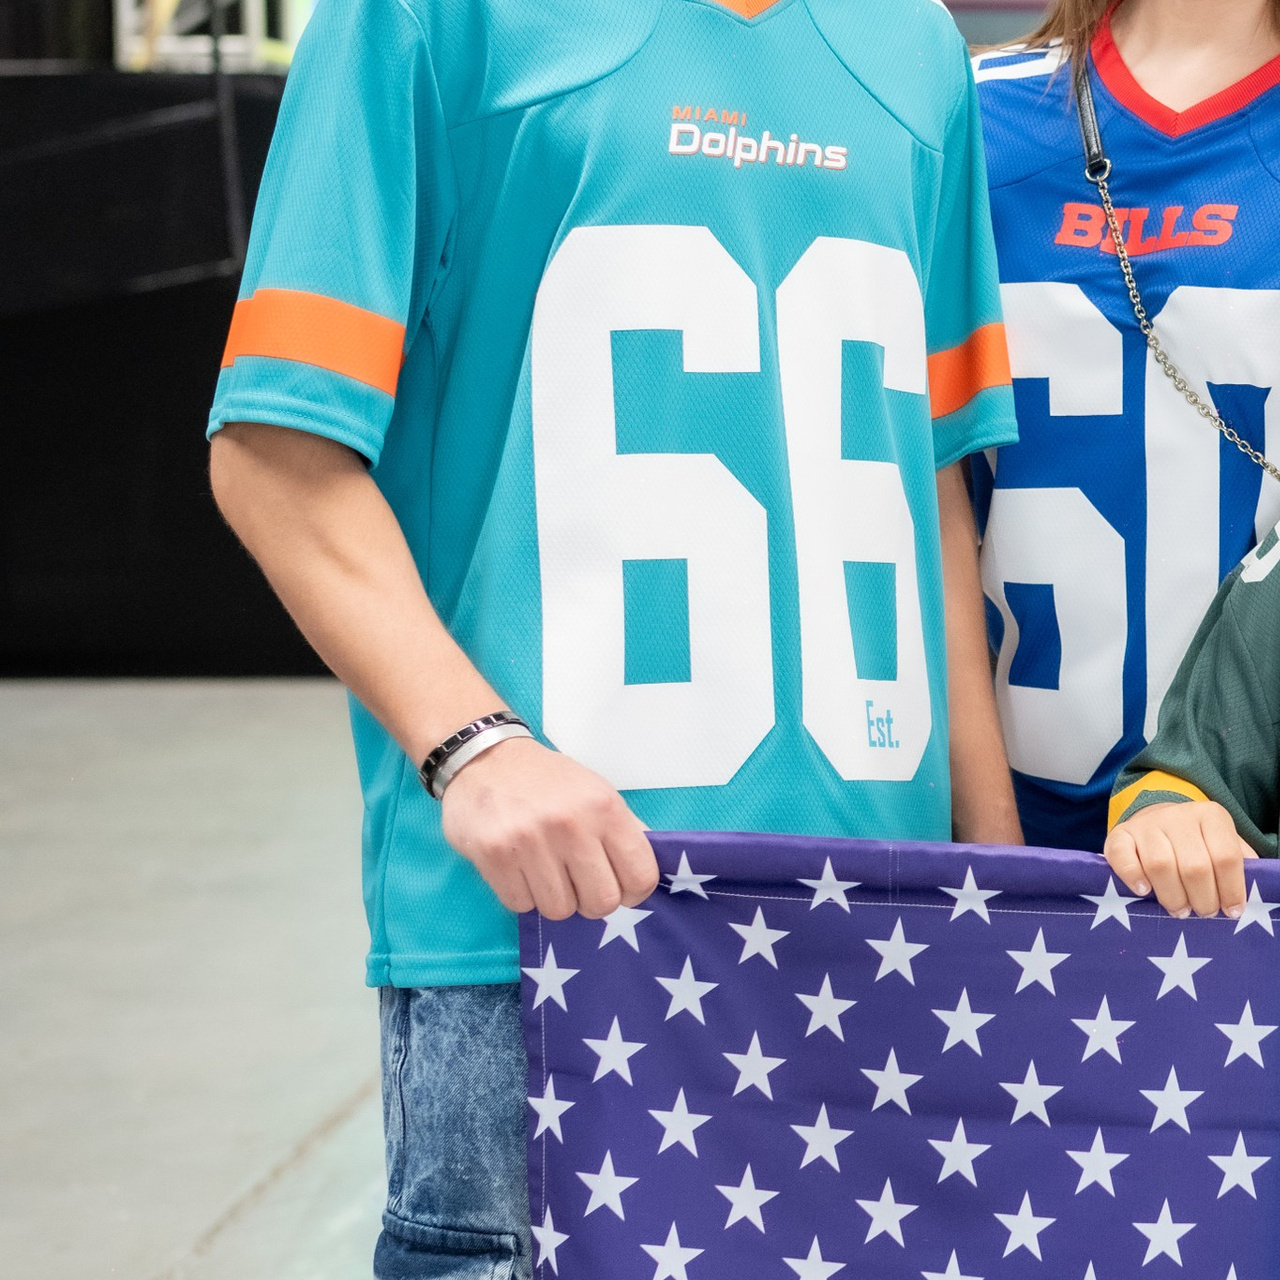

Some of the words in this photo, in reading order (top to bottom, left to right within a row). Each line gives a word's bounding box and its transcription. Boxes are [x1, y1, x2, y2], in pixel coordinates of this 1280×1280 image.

[672, 105, 748, 127] MIAMI
[668, 122, 849, 171] Dolphins
[1053, 201, 1240, 257] BILLS
[532, 223, 932, 791] 66
[865, 699, 900, 749] Est.
